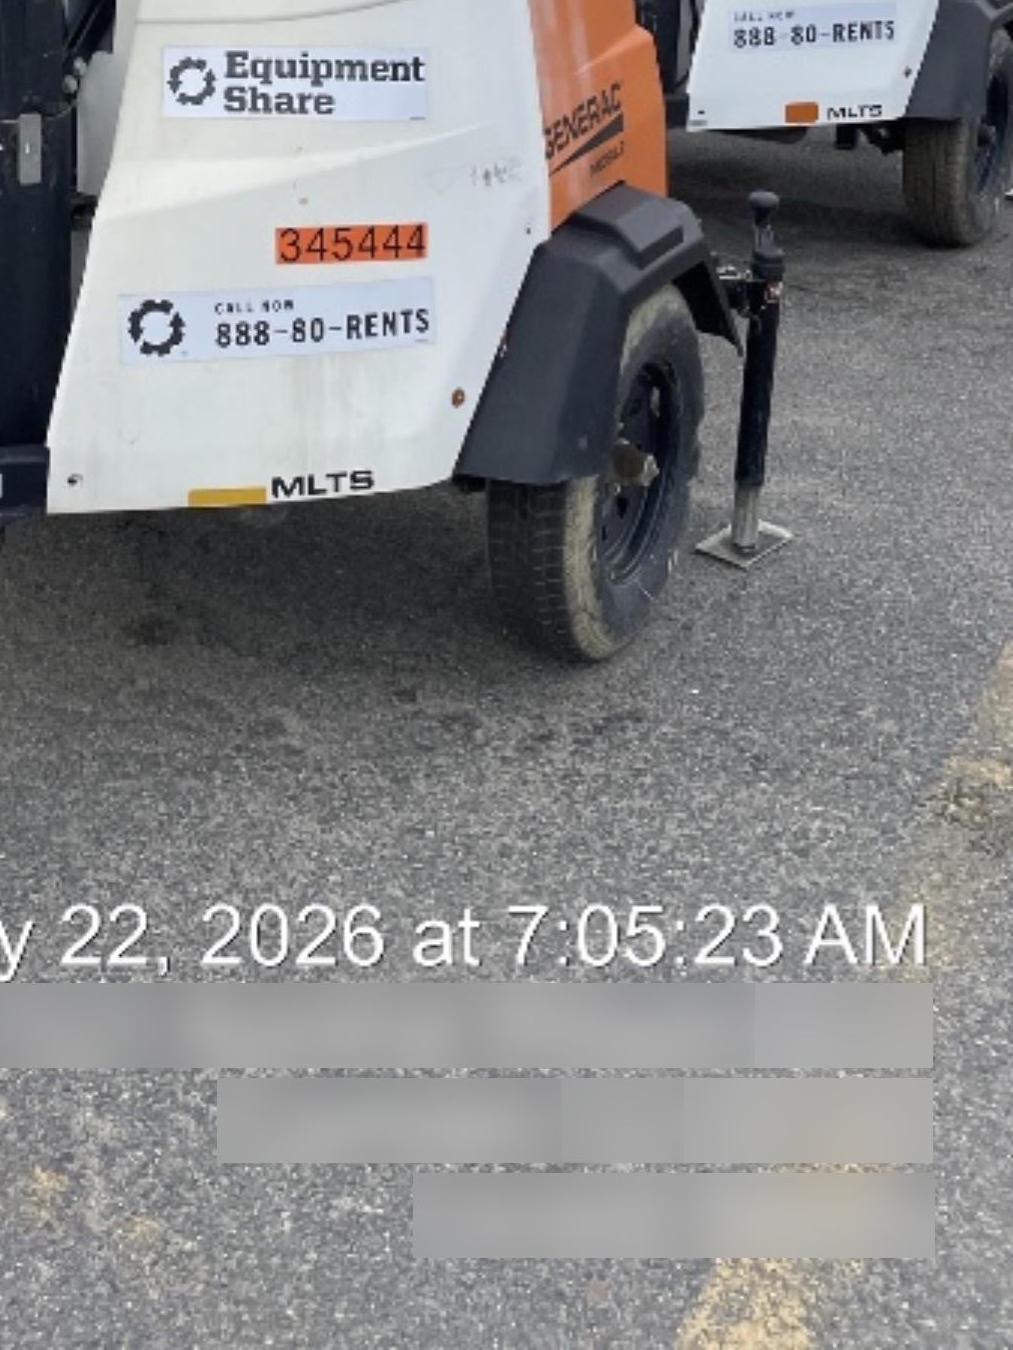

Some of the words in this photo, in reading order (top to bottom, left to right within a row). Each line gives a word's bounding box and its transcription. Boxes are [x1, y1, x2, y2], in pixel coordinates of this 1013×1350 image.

[224, 50, 426, 87] Equipment
[224, 87, 336, 114] Share
[827, 104, 883, 120] MLTS
[279, 224, 426, 263] 345444
[215, 308, 430, 349] 888-80-RENTS
[271, 470, 375, 498] MLTS
